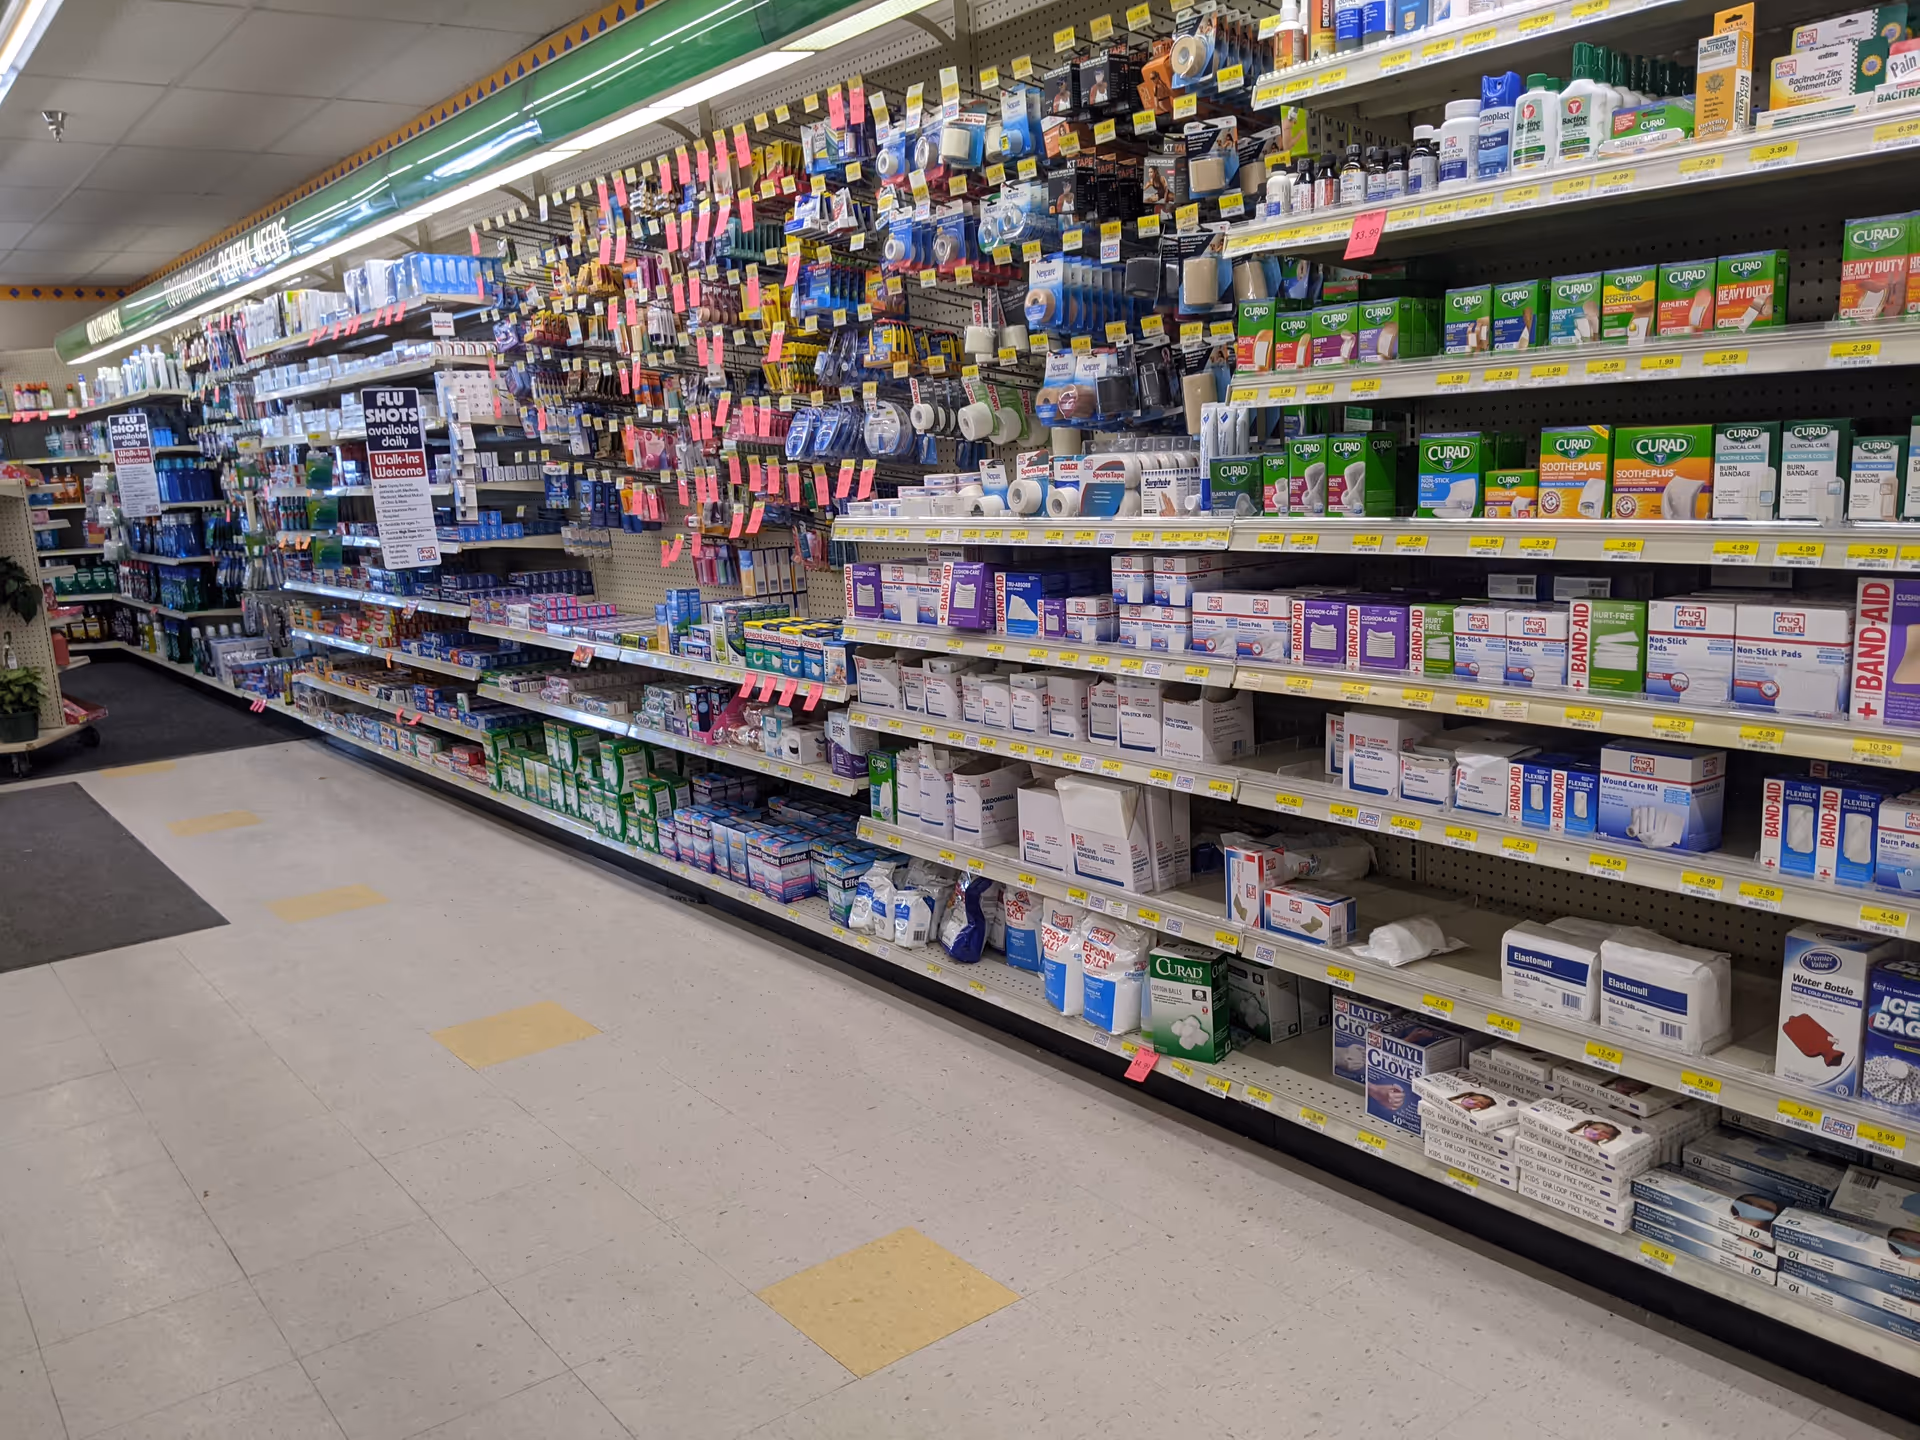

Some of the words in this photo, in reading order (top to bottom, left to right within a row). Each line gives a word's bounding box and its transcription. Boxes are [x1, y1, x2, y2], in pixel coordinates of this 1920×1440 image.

[1109, 44, 1126, 55] TAPE
[1699, 38, 1737, 55] BACITRAYCIN
[1722, 46, 1736, 56] PLUS
[1889, 54, 1917, 78] Pain
[1788, 72, 1826, 86] Bacitracin
[1826, 68, 1843, 80] Zinc
[1793, 79, 1826, 93] Ointment
[1827, 76, 1843, 88] USP
[1562, 113, 1588, 127] Bactine
[1164, 144, 1173, 154] KT
[1769, 145, 1788, 155] 3.99
[1066, 159, 1076, 168] KT
[1076, 157, 1093, 168] TAPE
[1354, 228, 1380, 241] $3.99
[1853, 227, 1900, 244] CURAD
[217, 234, 258, 282] DENTAL
[253, 216, 291, 267] NEEDS
[1036, 267, 1056, 278] Nexcare
[1730, 260, 1762, 274] CURAD
[1844, 262, 1874, 278] HEAVY
[1876, 258, 1906, 274] DUTY
[1615, 274, 1643, 286] CURAD
[1668, 269, 1706, 284] CURAD
[1558, 281, 1593, 296] CURAD
[1718, 289, 1744, 302] HEAVY
[1746, 285, 1772, 297] DUTY
[1660, 300, 1689, 309] ATHLETIC
[1852, 344, 1872, 352] 2.99
[1658, 358, 1674, 366] 1.99
[1721, 353, 1738, 361] 2.99
[376, 391, 404, 407] FLU
[118, 416, 138, 424] FLU
[365, 408, 418, 424] SHOTS
[112, 424, 147, 434] SHOTS
[368, 423, 419, 436] available
[1726, 426, 1762, 440] CURAD
[1794, 424, 1831, 438] CURAD
[113, 432, 147, 440] available
[381, 435, 409, 448] daily
[1635, 436, 1688, 454] CURAD
[1790, 442, 1812, 450] CLINICAL
[118, 449, 148, 458] Walk-Ins
[374, 453, 420, 466] Walk-Ins
[118, 457, 150, 465] Welcome
[1542, 461, 1601, 472] SOOTHEPLUS
[374, 466, 424, 478] Welcome
[1059, 463, 1078, 472] COACH
[1616, 468, 1676, 479] SOOTHEPLUS
[1719, 464, 1738, 472] BURN
[1719, 470, 1750, 478] BANDAGE
[1144, 478, 1171, 490] Surgitube
[1420, 476, 1450, 485] NON-STICK
[1306, 608, 1340, 617] CUSHION-CARE
[1594, 610, 1635, 622] HURT-FREE
[1677, 607, 1702, 622] drug
[1361, 614, 1397, 624] CUSHION-CARE
[1678, 616, 1705, 628] mart
[1776, 614, 1801, 628] drug
[1778, 624, 1804, 634] mart
[1455, 635, 1482, 645] Non-Stick
[1648, 636, 1689, 646] Non-Stick
[1856, 582, 1890, 691] BAND-AID
[1455, 642, 1470, 650] Pads
[1508, 640, 1540, 648] Non-Stick
[1648, 644, 1668, 652] Pads
[1737, 646, 1779, 658] Non-Stick
[1780, 649, 1802, 659] Pads
[1120, 710, 1141, 718] NON-STICK
[1670, 720, 1687, 728] 2.29
[1758, 730, 1776, 738] 4.99
[1632, 756, 1653, 767] drug
[1633, 763, 1655, 774] mart
[1511, 766, 1521, 814] BAND-AID
[1568, 780, 1594, 790] FLEXIBLE
[1602, 776, 1624, 786] Wound
[1625, 780, 1644, 790] Care
[1646, 783, 1658, 792] Kit
[982, 792, 1015, 806] ABDOMINAL
[1553, 771, 1564, 819] BAND-AID
[1786, 790, 1816, 800] FLEXIBLE
[982, 804, 994, 812] PAD
[1766, 782, 1782, 838] BAND-AID
[1842, 798, 1876, 810] FLEXIBLE
[1821, 790, 1839, 848] BAND-AID
[1880, 837, 1898, 847] Burn
[1900, 840, 1920, 849] Pads
[781, 850, 807, 866] Efferdent
[1606, 859, 1622, 867] 4.99
[1700, 877, 1716, 886] 6.99
[1758, 888, 1775, 898] 2.59
[1880, 912, 1900, 922] 4.49
[1082, 940, 1116, 964] EPSOM
[1084, 952, 1110, 970] SALT
[1514, 952, 1553, 968] Elastomull
[1806, 954, 1834, 964] Premier
[1156, 958, 1203, 979] CURAD
[1810, 961, 1830, 970] Value
[1152, 984, 1168, 994] COTTON
[1168, 986, 1182, 996] BALLS
[1608, 977, 1648, 997] Elastomull
[1792, 972, 1822, 988] Water
[1824, 982, 1854, 996] Bottle
[1808, 990, 1822, 998] COLD
[1822, 992, 1859, 1008] APPLICATIONS
[1881, 996, 1920, 1018] ICE
[1351, 1005, 1388, 1024] LATEX
[1873, 1012, 1920, 1038] BAG
[1384, 1039, 1422, 1064] VINYL
[1368, 1048, 1422, 1081] GLOVES
[1554, 1094, 1602, 1116] KIDS
[1797, 1108, 1814, 1118] 7.99
[1392, 1115, 1402, 1124] 50
[1834, 1121, 1853, 1132] PRO
[1522, 1116, 1537, 1127] KIDS
[1564, 1135, 1577, 1145] FACE
[1579, 1141, 1595, 1154] MASK
[1877, 1131, 1896, 1142] 9.99
[1749, 1228, 1760, 1238] 10
[1752, 1249, 1764, 1259] 10
[1750, 1266, 1762, 1276] 10
